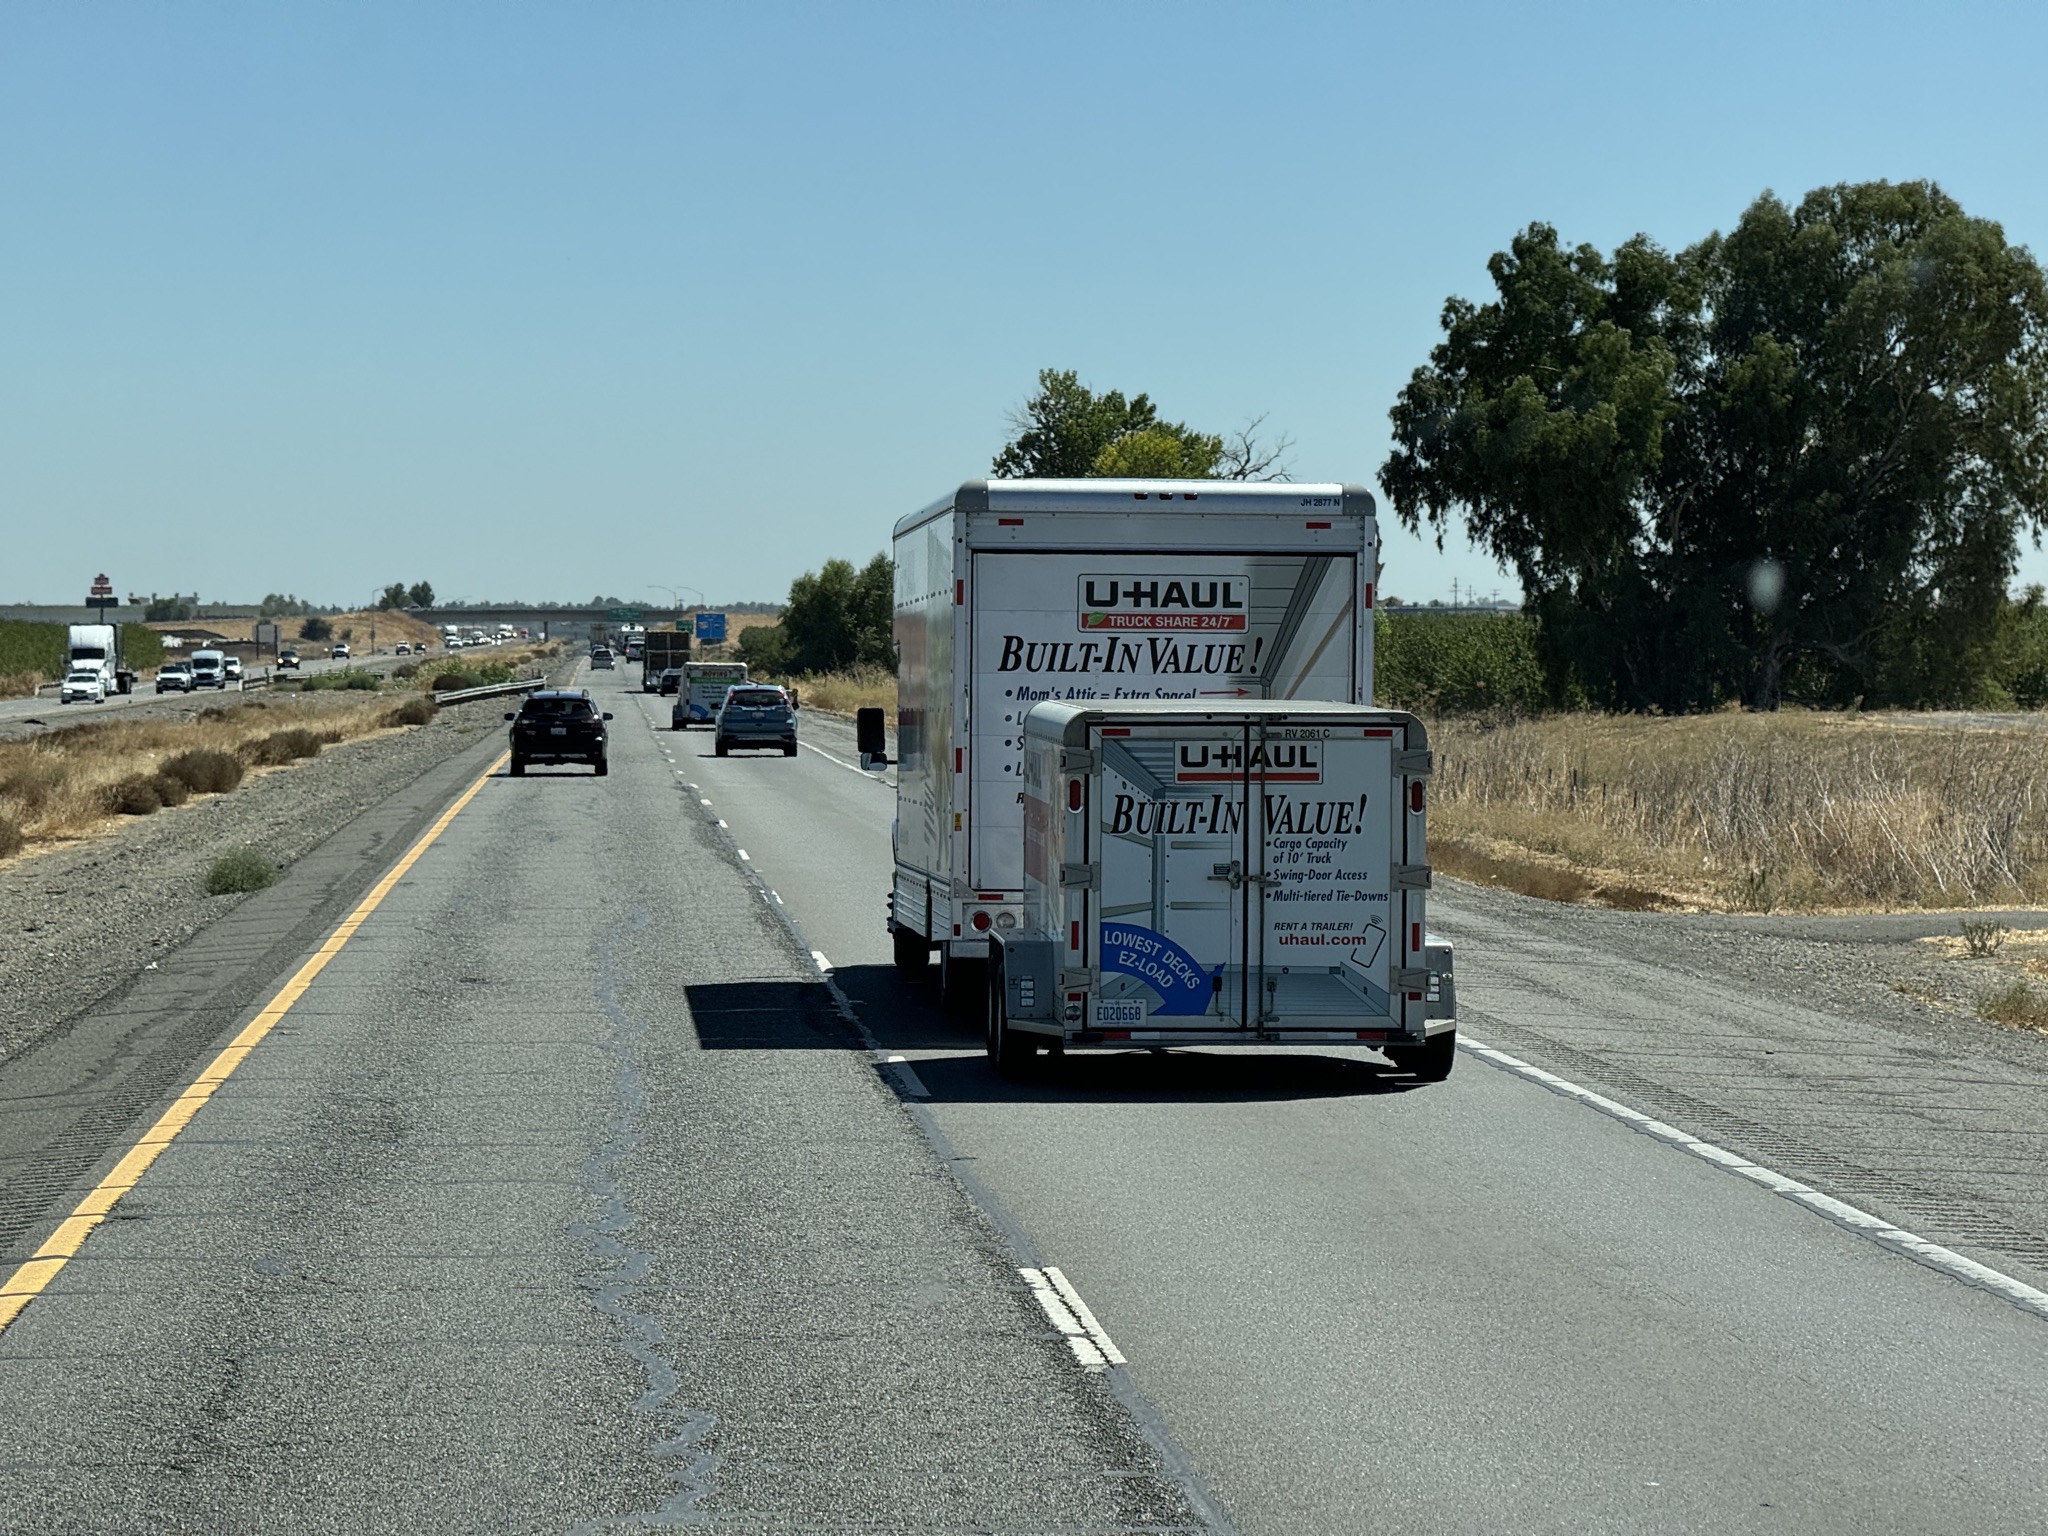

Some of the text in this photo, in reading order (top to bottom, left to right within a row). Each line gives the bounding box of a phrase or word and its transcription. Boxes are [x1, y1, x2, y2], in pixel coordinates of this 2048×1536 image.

[1300, 498, 1311, 507] JH
[1333, 498, 1340, 507] N
[1085, 581, 1243, 609] U-HAUL
[1109, 615, 1231, 629] TRUCK SHARE 24/7
[997, 635, 1264, 675] BUILT-IN VALUE!
[1016, 686, 1062, 701] Mom's
[1065, 686, 1097, 700] Attic
[1114, 687, 1150, 700] Extra
[1285, 729, 1331, 739] RV 2061 C
[1180, 745, 1318, 768] U-HAUL
[1110, 793, 1368, 835] BUILT-IN VALUE!
[1273, 837, 1348, 852] Cargo Capacity
[1273, 851, 1284, 864] of
[1307, 851, 1332, 864] Truck
[1273, 869, 1368, 883] Swing-Door Access
[1273, 889, 1389, 902] Multi-tiered Tie-Downs
[1273, 922, 1354, 931] RENT A TRAILER!
[1279, 933, 1367, 946] uhaul.com
[1104, 930, 1201, 989] LOWEST DECKS
[1118, 950, 1174, 988] EZ-LOAD
